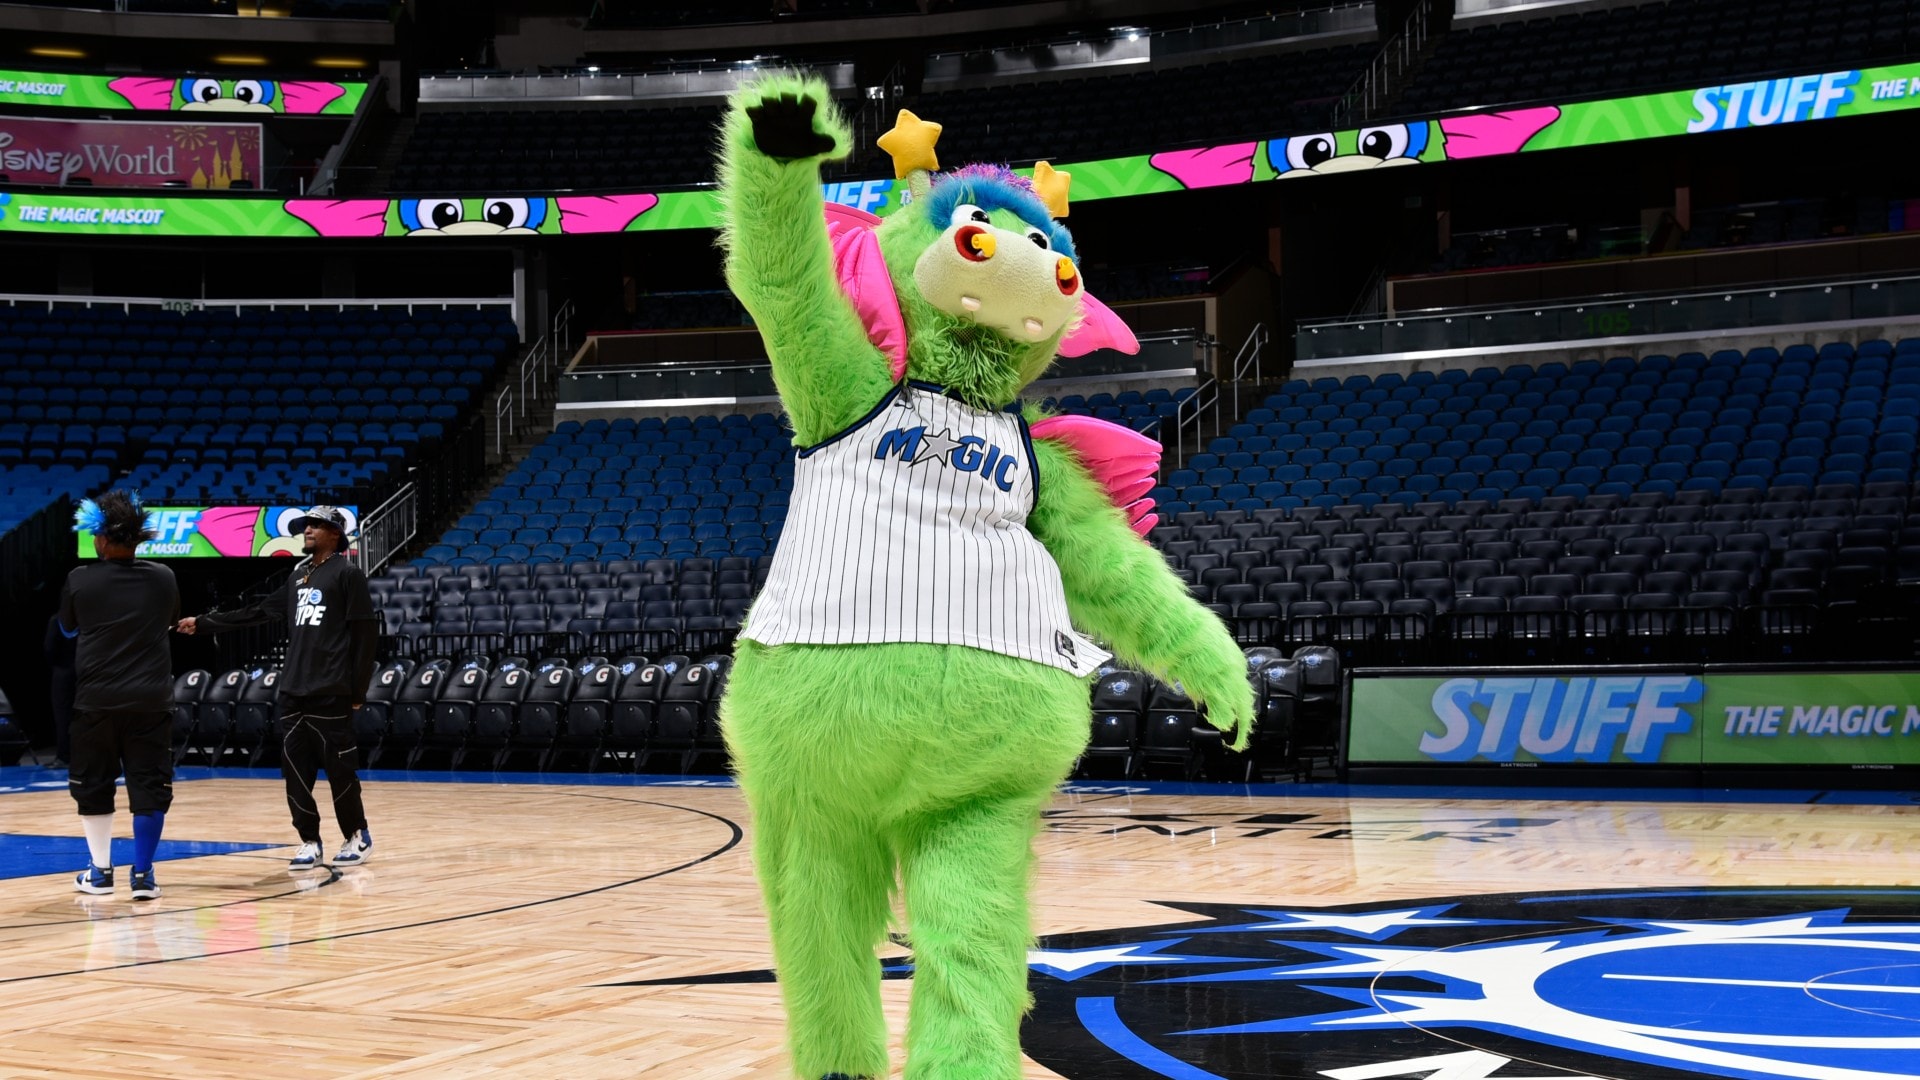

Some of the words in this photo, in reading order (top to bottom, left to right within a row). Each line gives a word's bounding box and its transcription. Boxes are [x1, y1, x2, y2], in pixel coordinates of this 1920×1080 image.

[16, 82, 66, 96] MASCOT
[1687, 70, 1857, 133] STUFF
[1871, 79, 1908, 101] THE
[82, 144, 176, 175] World
[19, 206, 48, 222] THE
[50, 206, 100, 224] MAGIC
[102, 208, 164, 225] MASCOT
[150, 543, 193, 555] MASCOT
[187, 672, 200, 686] G
[227, 672, 240, 685] G
[264, 672, 277, 686] G
[382, 670, 395, 684] G
[421, 670, 434, 684] G
[464, 670, 477, 684] G
[506, 670, 520, 685] G
[549, 670, 563, 684] G
[596, 667, 609, 683] G
[641, 667, 655, 683] G
[687, 667, 701, 682] G
[1419, 676, 1702, 761] STUFF
[1724, 705, 1784, 736] THE
[1787, 704, 1897, 737] MAGIC
